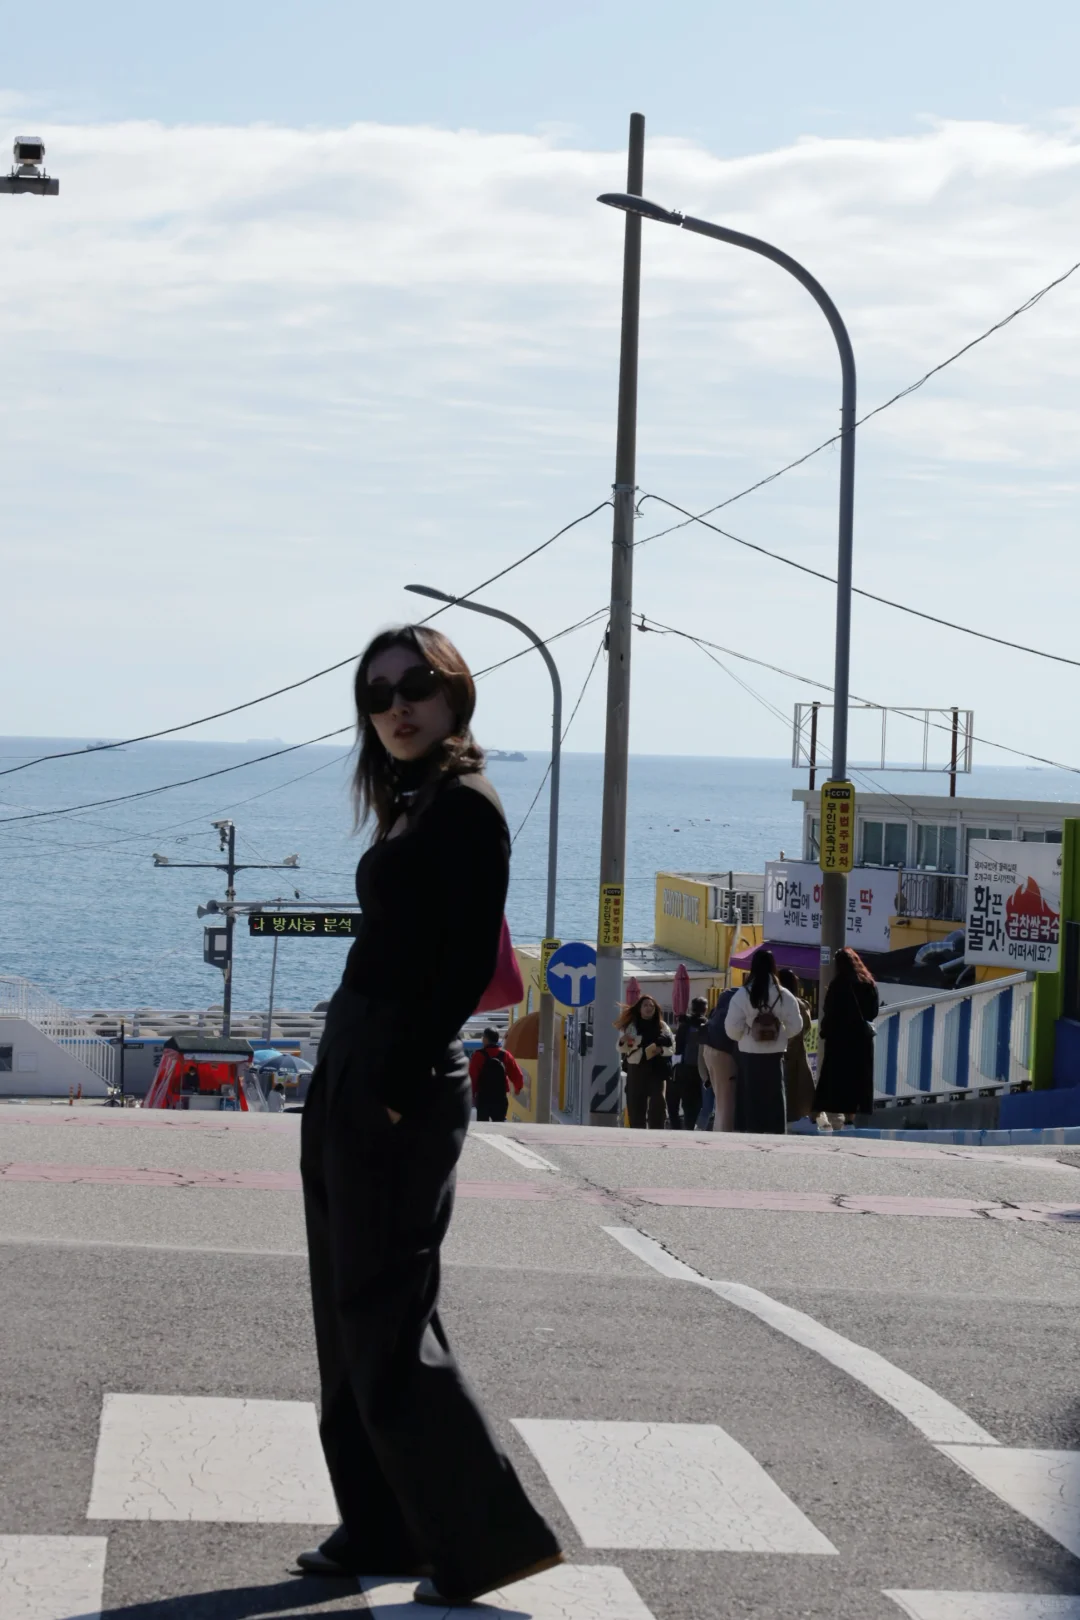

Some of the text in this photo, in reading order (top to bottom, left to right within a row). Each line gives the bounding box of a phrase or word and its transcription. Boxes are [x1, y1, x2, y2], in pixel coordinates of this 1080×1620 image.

[825, 802, 836, 867] 무인단속구간
[838, 802, 850, 867] 불법주정차
[663, 888, 683, 920] PHOTO
[776, 881, 810, 909] 아침에
[859, 888, 874, 916] 딱
[974, 885, 1003, 918] 화끈
[273, 917, 316, 932] 방사능
[324, 917, 352, 932] 분석
[783, 910, 809, 927] 낮에는
[811, 913, 823, 929] 별
[968, 914, 1005, 952] 불맛!
[1008, 912, 1060, 941] 곱창쌀국수
[1008, 942, 1052, 962] 어떠세요?
